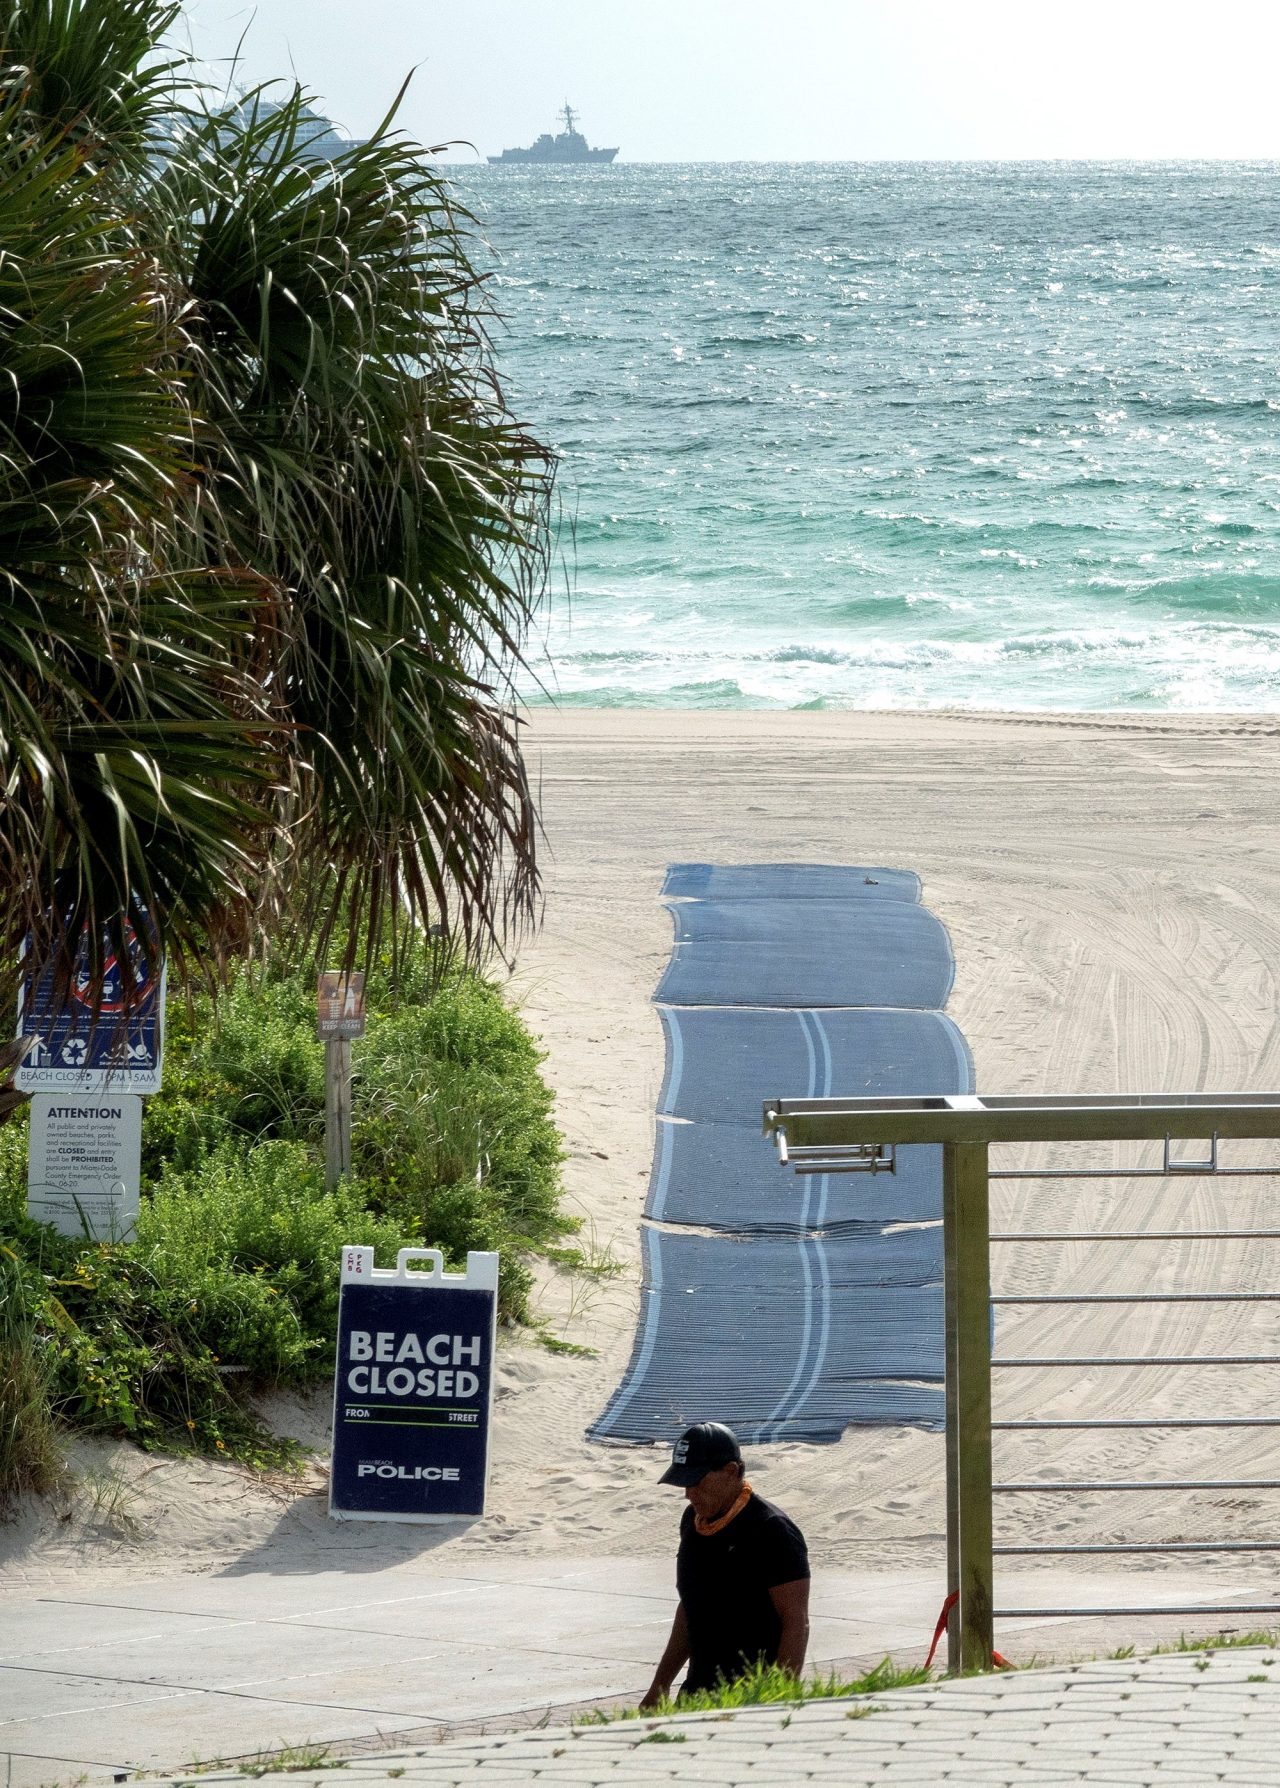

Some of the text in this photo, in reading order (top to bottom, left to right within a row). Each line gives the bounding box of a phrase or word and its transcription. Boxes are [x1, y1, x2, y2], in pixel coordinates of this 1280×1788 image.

[20, 1071, 53, 1081] BEACH
[55, 1071, 92, 1082] CLOSED
[133, 1073, 156, 1083] 5AM
[47, 1107, 122, 1119] ATTENTION
[57, 1123, 75, 1131] public
[91, 1123, 116, 1131] privately
[97, 1139, 122, 1147] facilities
[100, 1149, 116, 1157] entry
[45, 1171, 122, 1181] County Emergency Order
[349, 1331, 481, 1366] BEACH
[347, 1366, 480, 1398] CLOSED
[357, 1464, 460, 1481] POLICE
